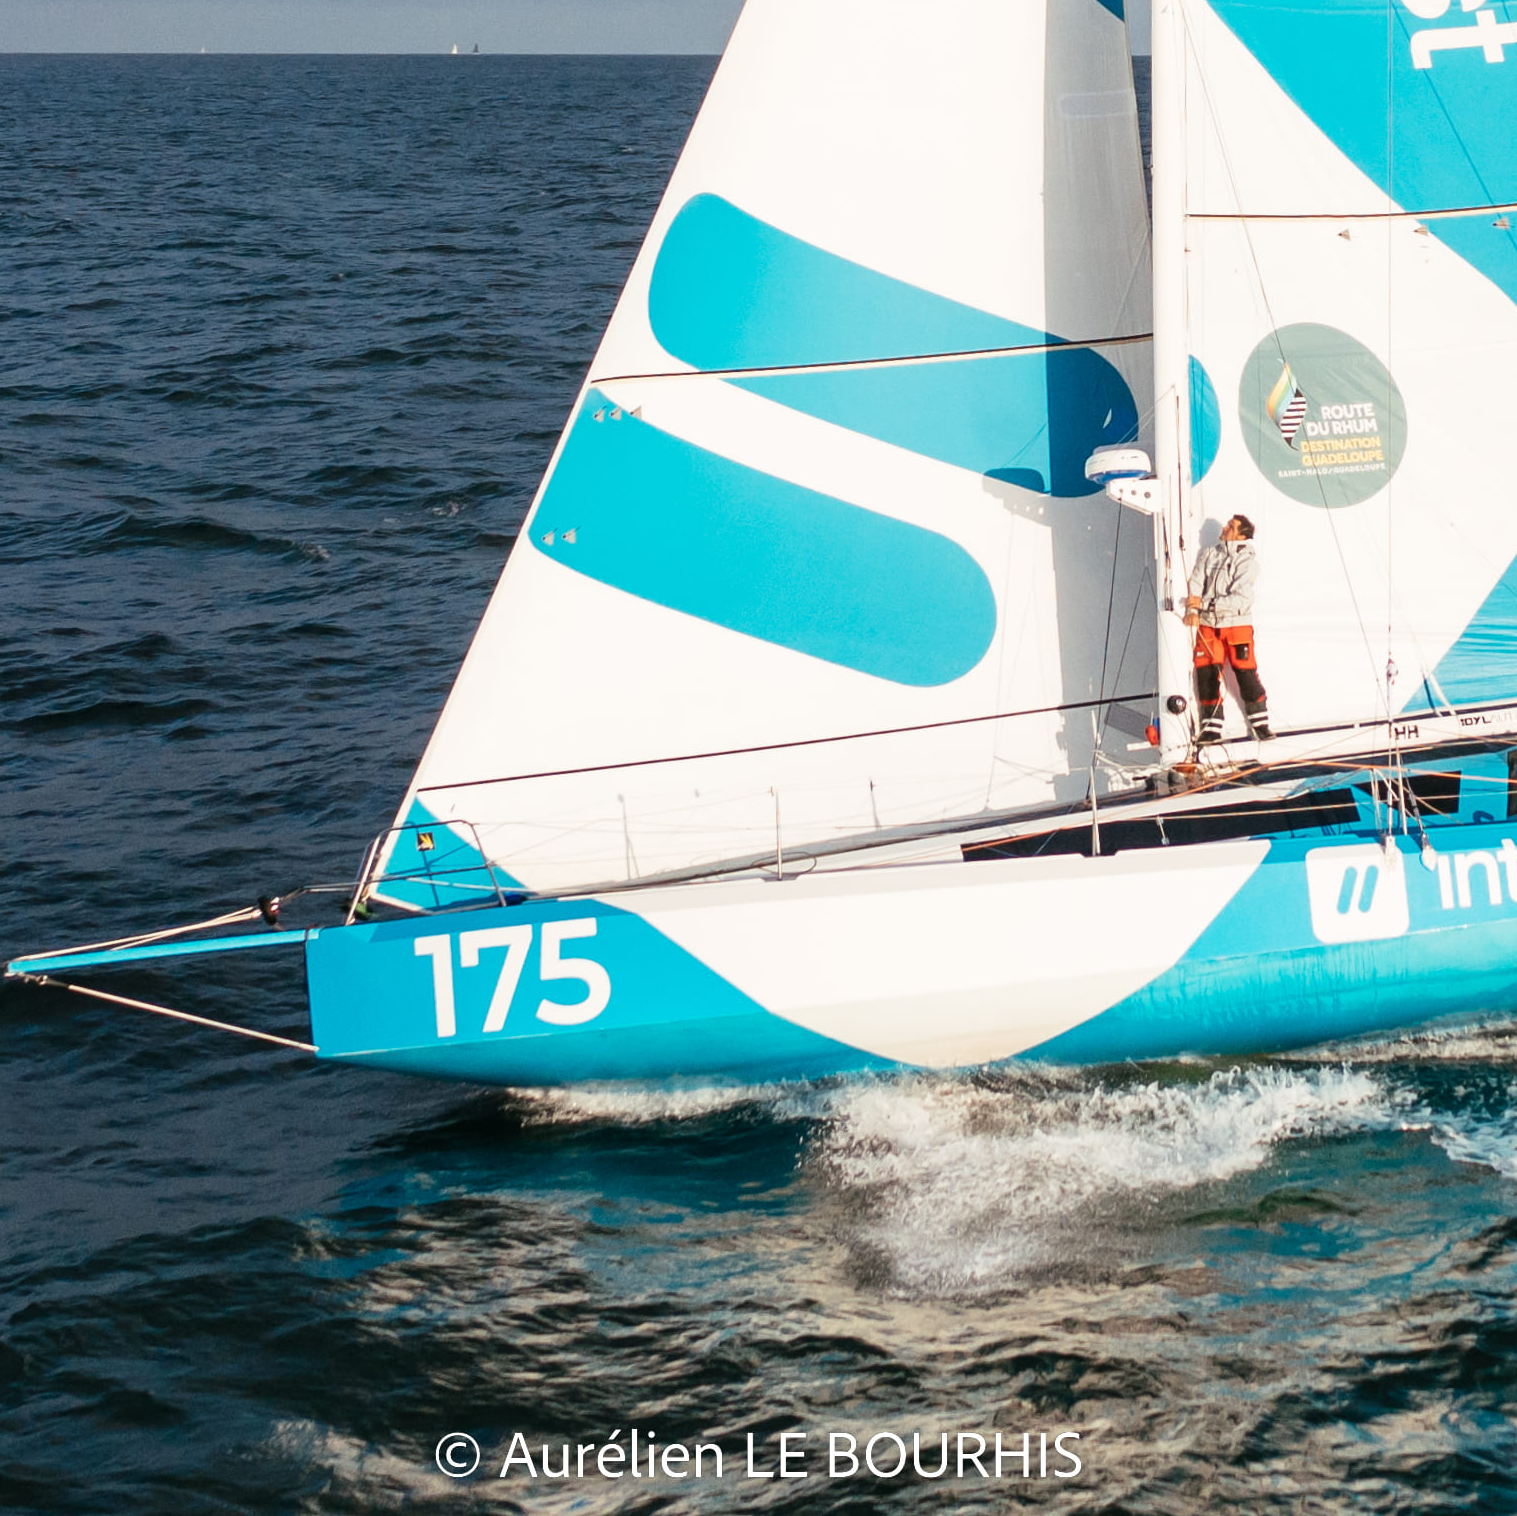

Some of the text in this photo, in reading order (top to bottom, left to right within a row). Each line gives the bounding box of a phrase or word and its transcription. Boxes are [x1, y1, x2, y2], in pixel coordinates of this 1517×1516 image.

[1321, 402, 1375, 420] ROUTE
[1306, 418, 1378, 436] DU RHUM
[1300, 436, 1382, 453] DESTINATION
[1301, 449, 1385, 467] GUADELOUPE
[413, 917, 612, 1039] 175
